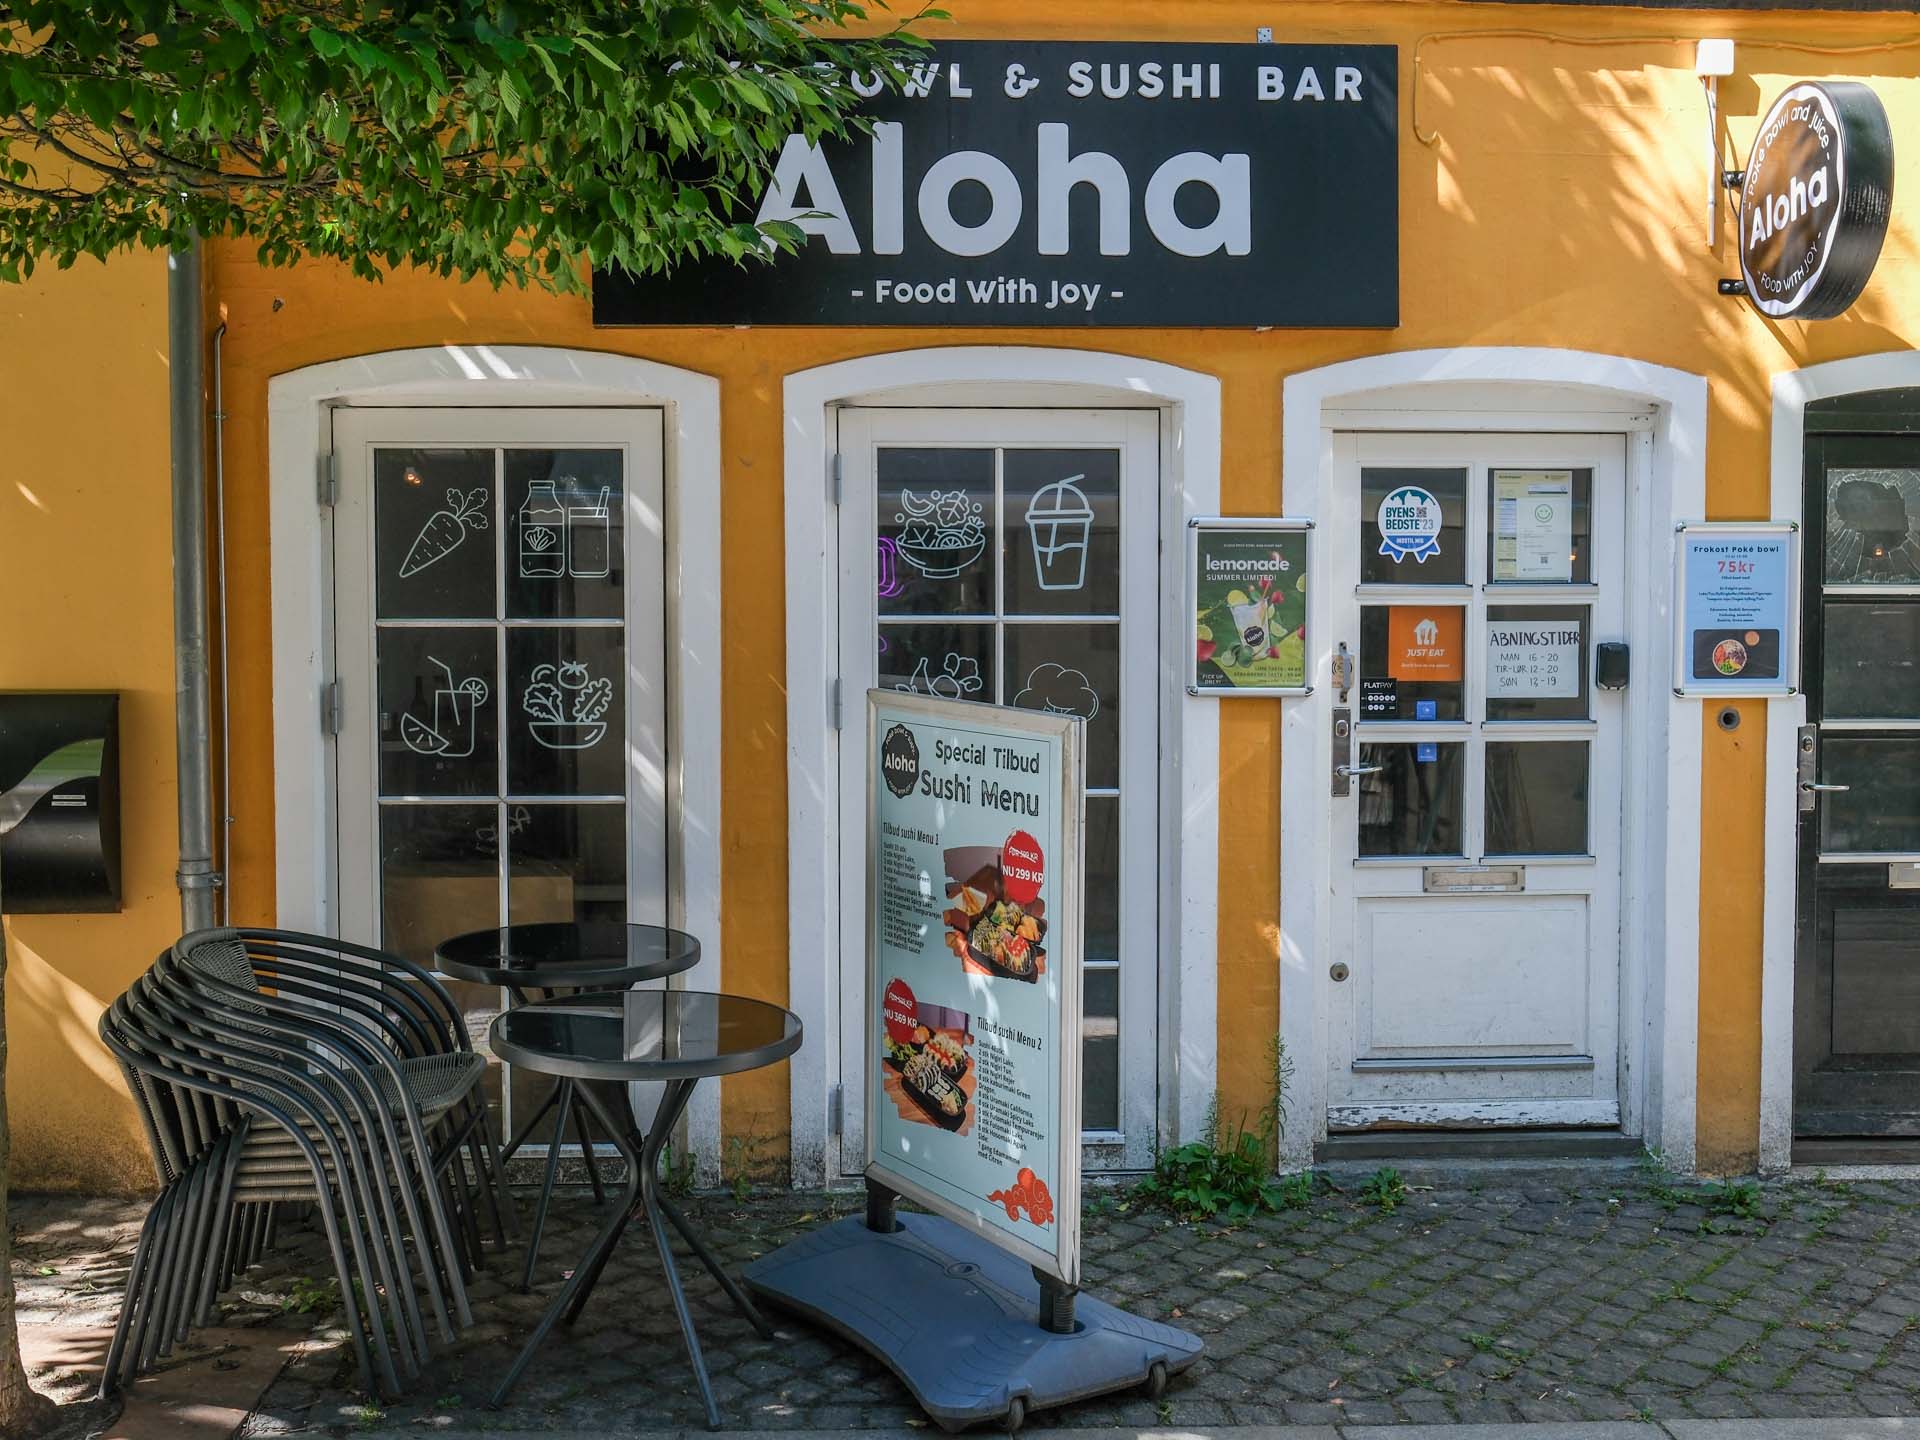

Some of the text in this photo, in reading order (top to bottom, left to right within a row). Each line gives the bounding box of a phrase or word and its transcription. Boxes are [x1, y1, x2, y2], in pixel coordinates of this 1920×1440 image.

[1004, 66, 1039, 97] &
[1067, 62, 1221, 100] SUSHI
[1258, 66, 1364, 101] BAR
[1790, 104, 1811, 122] and
[754, 121, 1251, 256] Aloha
[1750, 164, 1828, 250] Aloha
[1760, 242, 1818, 293] FOOD WITH JOY
[876, 279, 956, 304] Food
[966, 278, 1037, 304] With
[1045, 279, 1101, 312] Joy
[1385, 507, 1415, 518] BYENS
[1385, 519, 1420, 530] BEDSTE
[1694, 545, 1729, 553] Frokost
[1757, 545, 1779, 553] bowl
[1206, 553, 1290, 571] lemonade
[1206, 574, 1241, 582] SUMMER
[1407, 649, 1445, 657] JUST EAT
[1500, 653, 1520, 662] MAN
[1547, 653, 1559, 662] 20
[1547, 665, 1559, 674] 20
[1499, 677, 1518, 688] SØN
[1547, 676, 1557, 686] 19
[885, 753, 915, 773] Aloha
[935, 740, 985, 765] Special
[993, 748, 1040, 774] Tilbud
[920, 770, 1040, 817] Sushi Menu
[883, 822, 900, 837] Tilbud
[901, 828, 916, 841] sushi
[917, 831, 934, 845] Menu
[1002, 864, 1044, 884] NU 299 KR
[907, 1016, 918, 1029] KR
[977, 1016, 1042, 1051] Tilbud sushi Menu 2
[989, 1051, 1002, 1064] Nigiri
[989, 1060, 1002, 1073] Nigiri
[989, 1069, 1002, 1081] Nigiri
[989, 1093, 1009, 1109] Uramaki
[1016, 1087, 1030, 1101] Green
[989, 1102, 1009, 1118] Uramaki
[1009, 1110, 1022, 1124] Spicy
